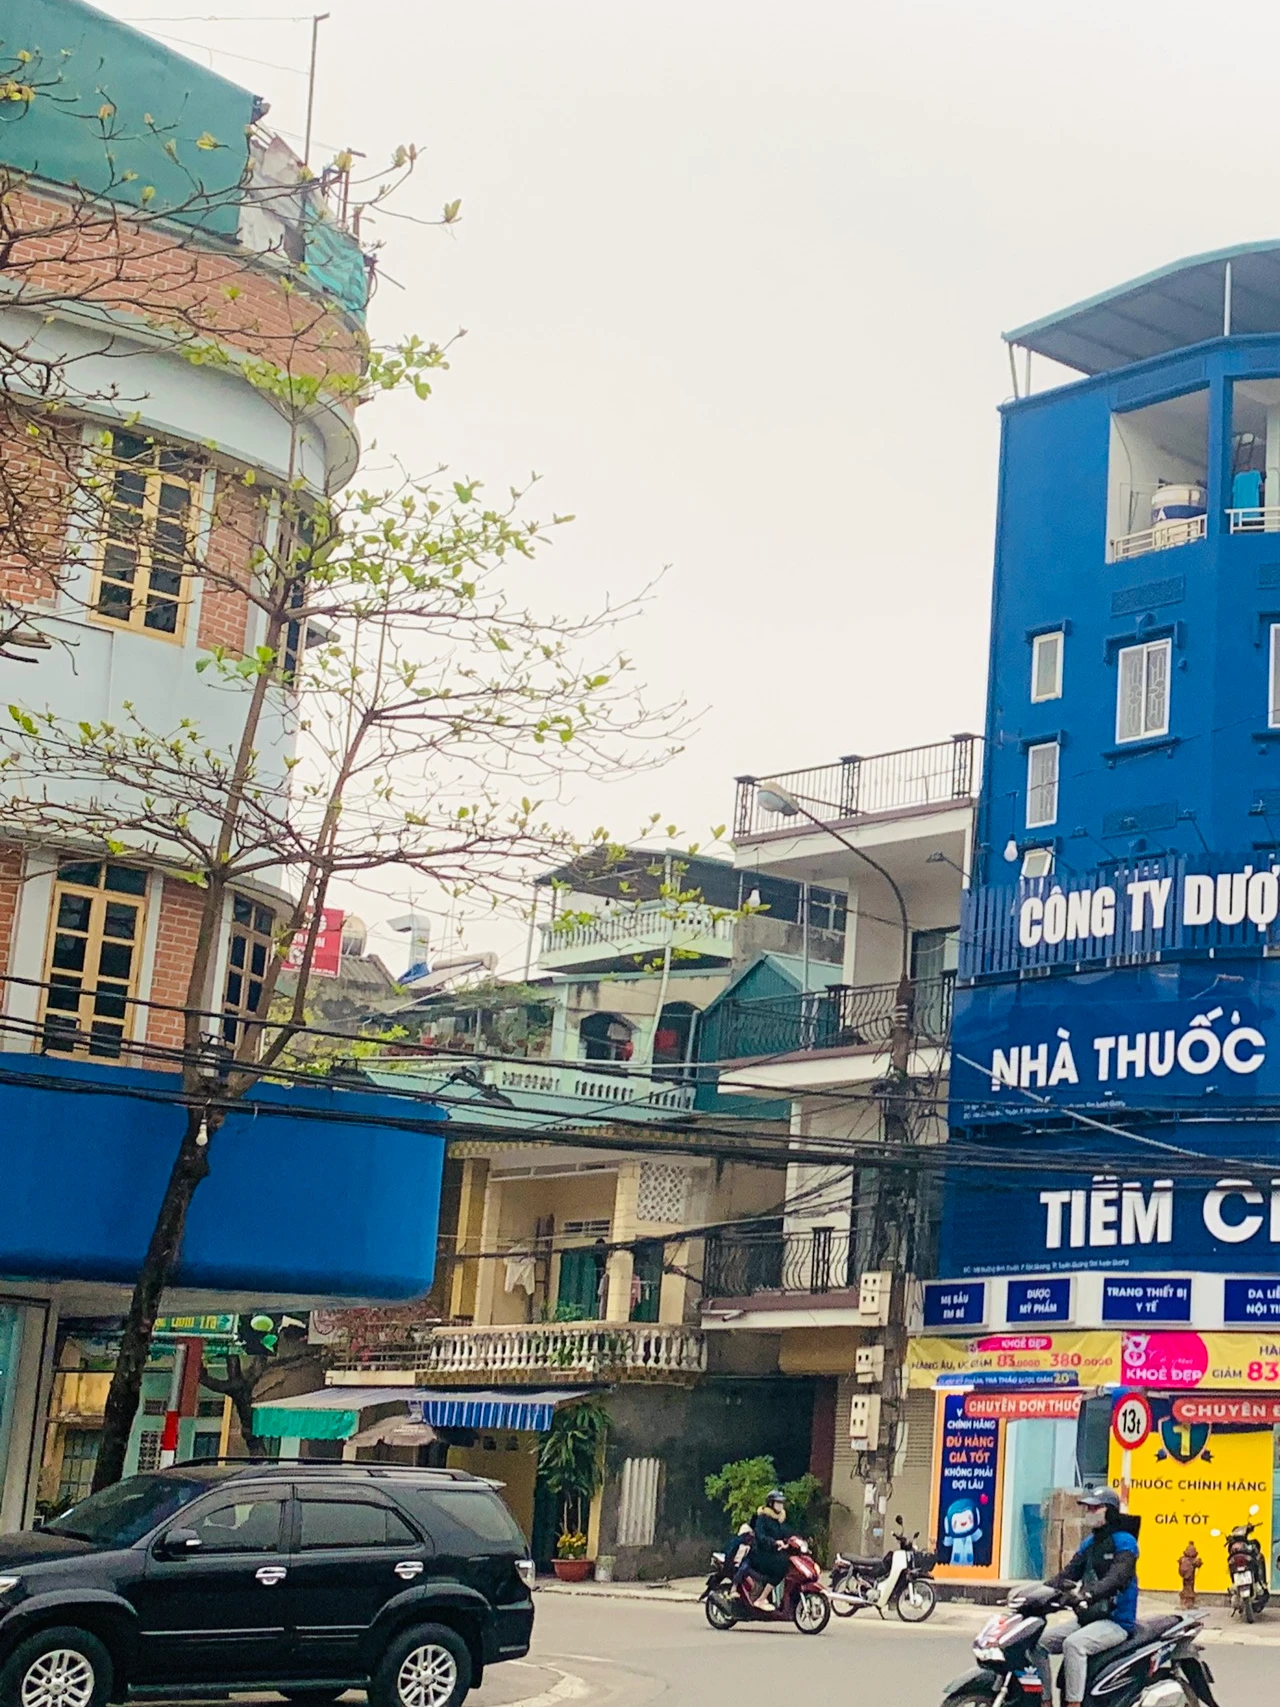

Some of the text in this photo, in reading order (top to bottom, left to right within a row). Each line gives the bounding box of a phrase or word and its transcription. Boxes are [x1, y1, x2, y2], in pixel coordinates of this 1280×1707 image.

[1019, 885, 1116, 948] CÔNG
[1127, 876, 1173, 932] TY
[991, 1006, 1266, 1092] NHÀ THUỐC
[1039, 1166, 1174, 1249] TIÊM
[1107, 1284, 1188, 1301] TRANG THIẾT BỊ
[1248, 1288, 1264, 1300] DA
[1136, 1299, 1159, 1313] Y TẾ
[1246, 1301, 1267, 1317] NỘI
[1171, 1368, 1203, 1384] ĐẸP
[969, 1396, 1017, 1413] CHUYÊN
[1049, 1394, 1082, 1413] THUỐ
[1181, 1401, 1266, 1417] CHUYÊN
[947, 1418, 972, 1430] CHÍNH
[1122, 1408, 1141, 1435] 13t
[949, 1447, 990, 1464] GIÁ TỐT
[944, 1466, 973, 1478] KHÔNG
[968, 1478, 985, 1490] LÂU
[1131, 1476, 1173, 1490] THUỐC
[1178, 1477, 1222, 1491] CHÍNH
[1226, 1479, 1267, 1492] HÃNG
[1155, 1511, 1210, 1525] GIÁ TỐT
